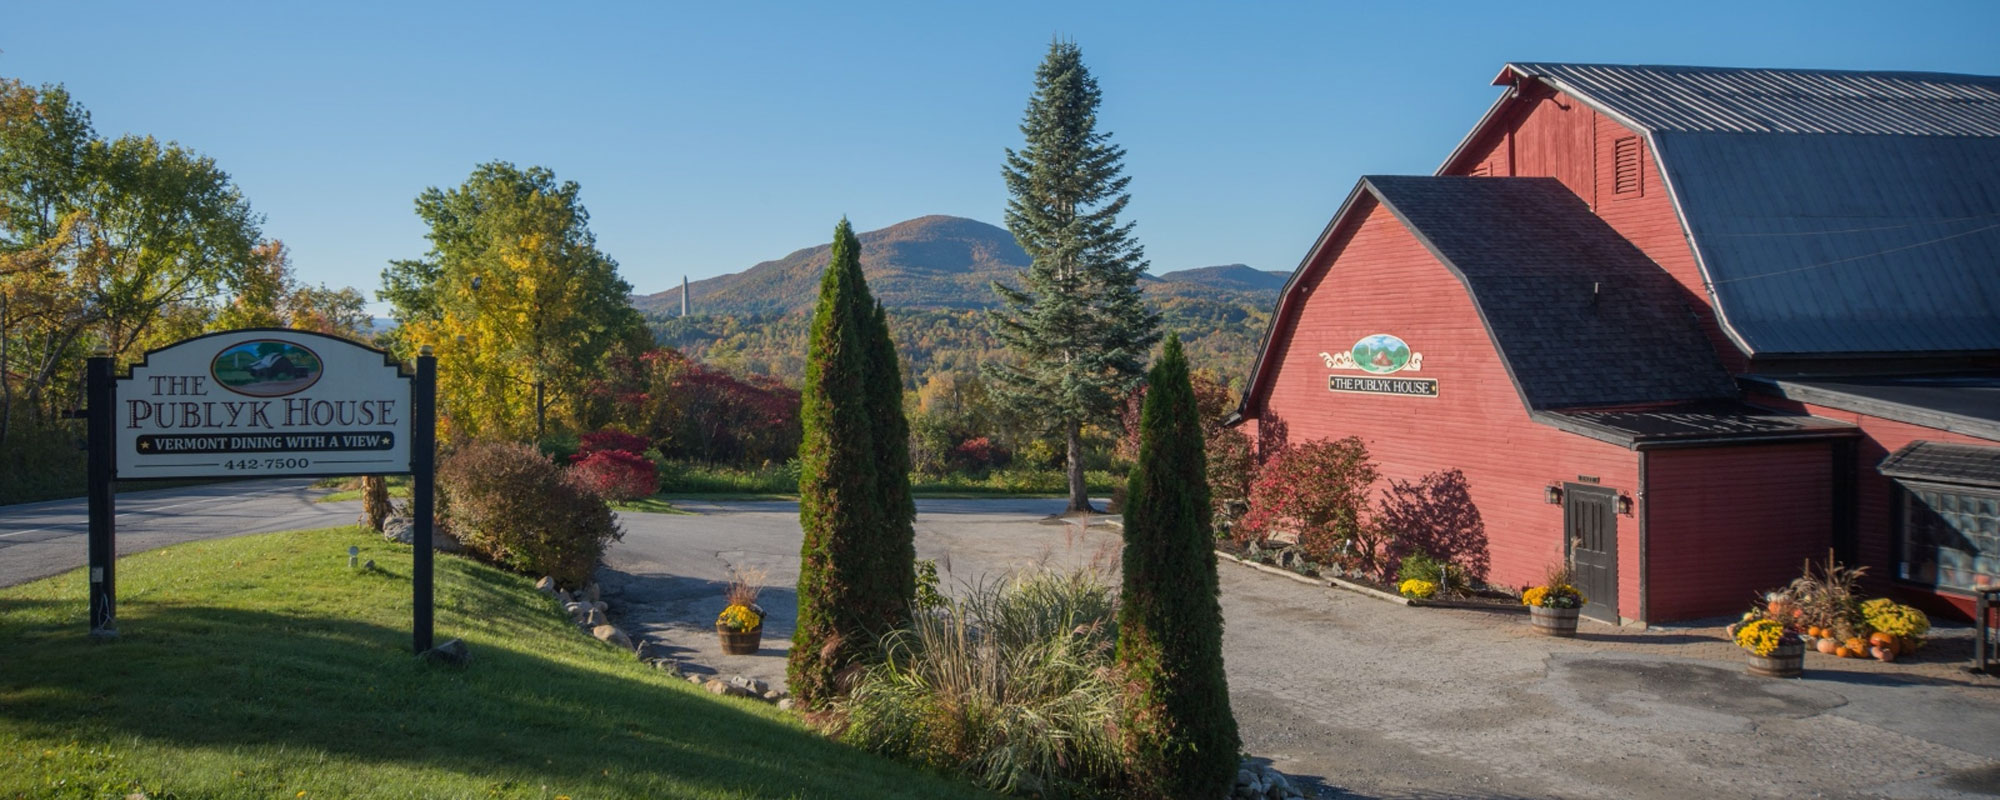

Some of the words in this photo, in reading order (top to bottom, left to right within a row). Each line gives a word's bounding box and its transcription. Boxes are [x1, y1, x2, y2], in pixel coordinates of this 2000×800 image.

[148, 375, 208, 396] THE
[1335, 378, 1353, 389] THE
[1354, 379, 1391, 391] PUBLYK
[1393, 382, 1430, 394] HOUSE
[126, 399, 274, 429] PUBLYK
[282, 398, 399, 427] HOUSE
[155, 438, 228, 450] VERMONT
[231, 437, 283, 449] DINING
[286, 436, 326, 447] WITH
[329, 436, 339, 447] A
[343, 434, 381, 446] VIEW
[224, 457, 309, 470] 442-7500
